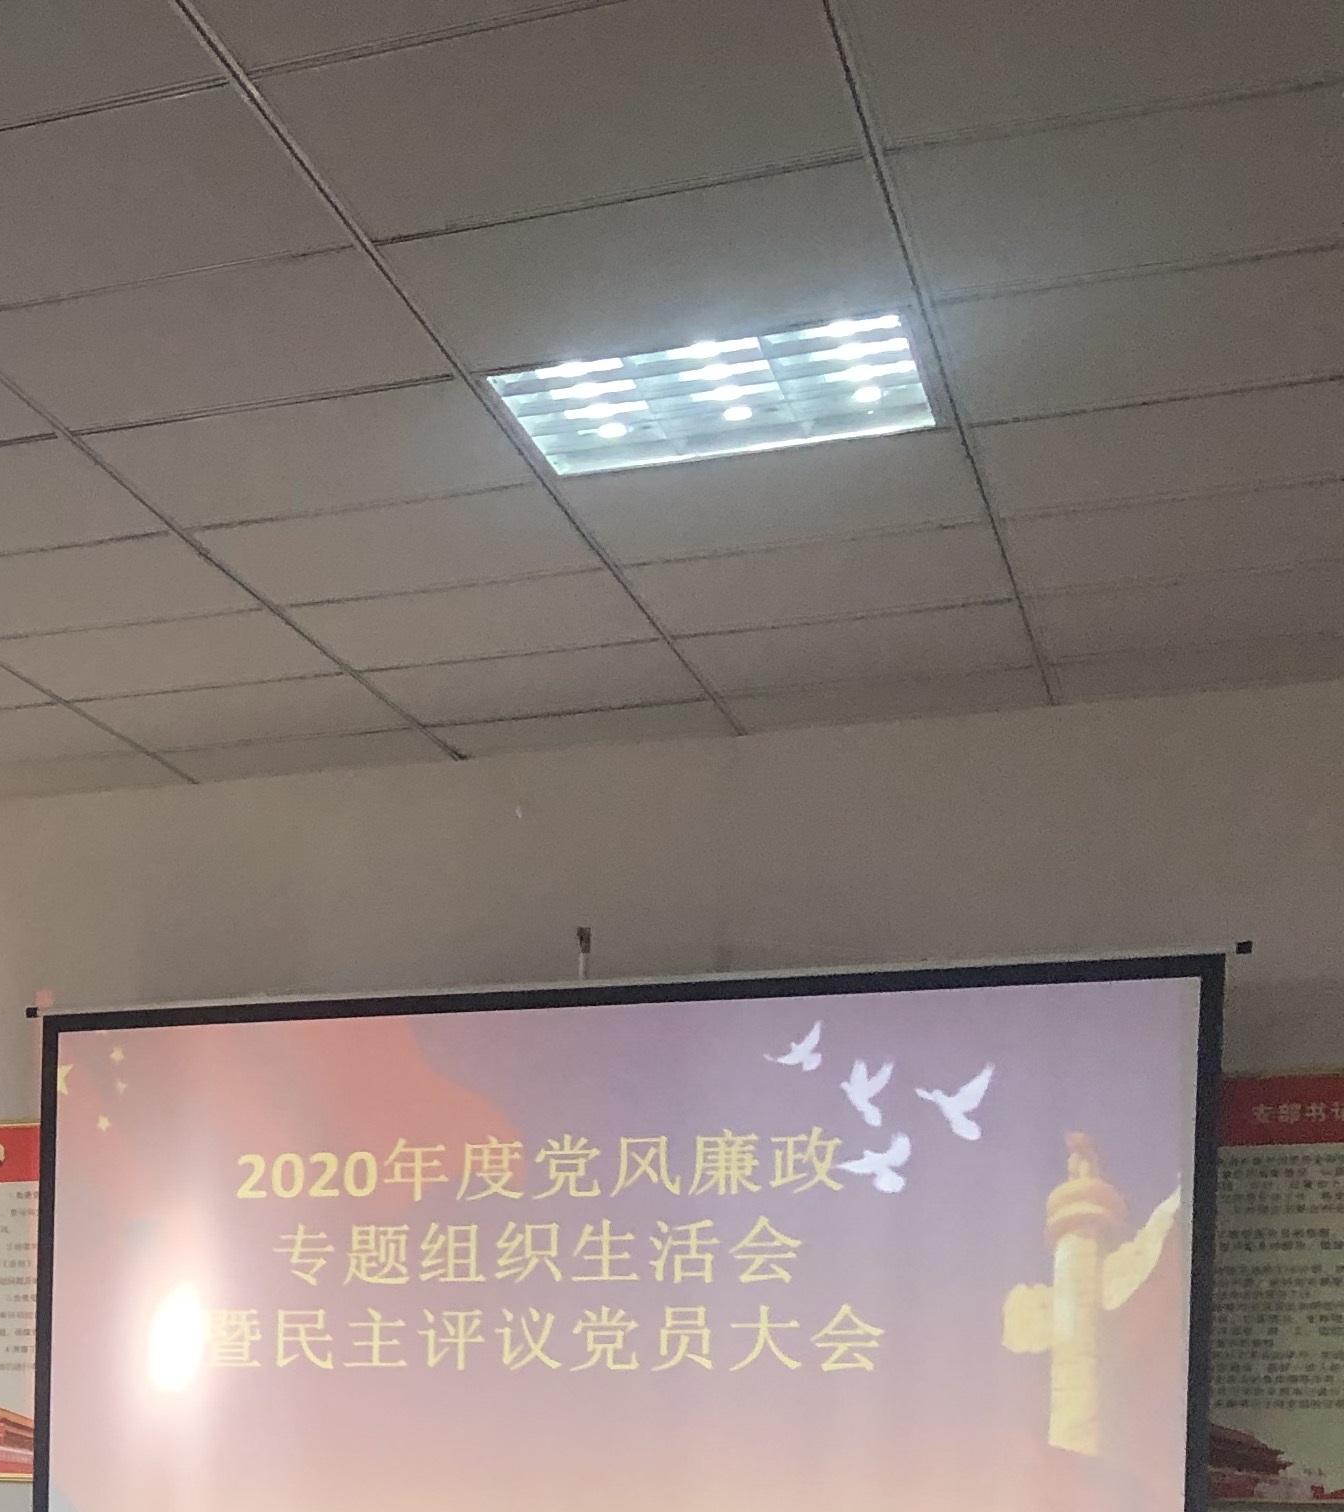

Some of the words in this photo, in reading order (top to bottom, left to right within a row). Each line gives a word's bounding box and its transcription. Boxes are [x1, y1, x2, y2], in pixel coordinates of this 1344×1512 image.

[236, 1127, 845, 1201] 2020年度党风廉政
[273, 1214, 802, 1286] 专题组织生活会
[208, 1303, 886, 1373] 暨民主评议党员大会
